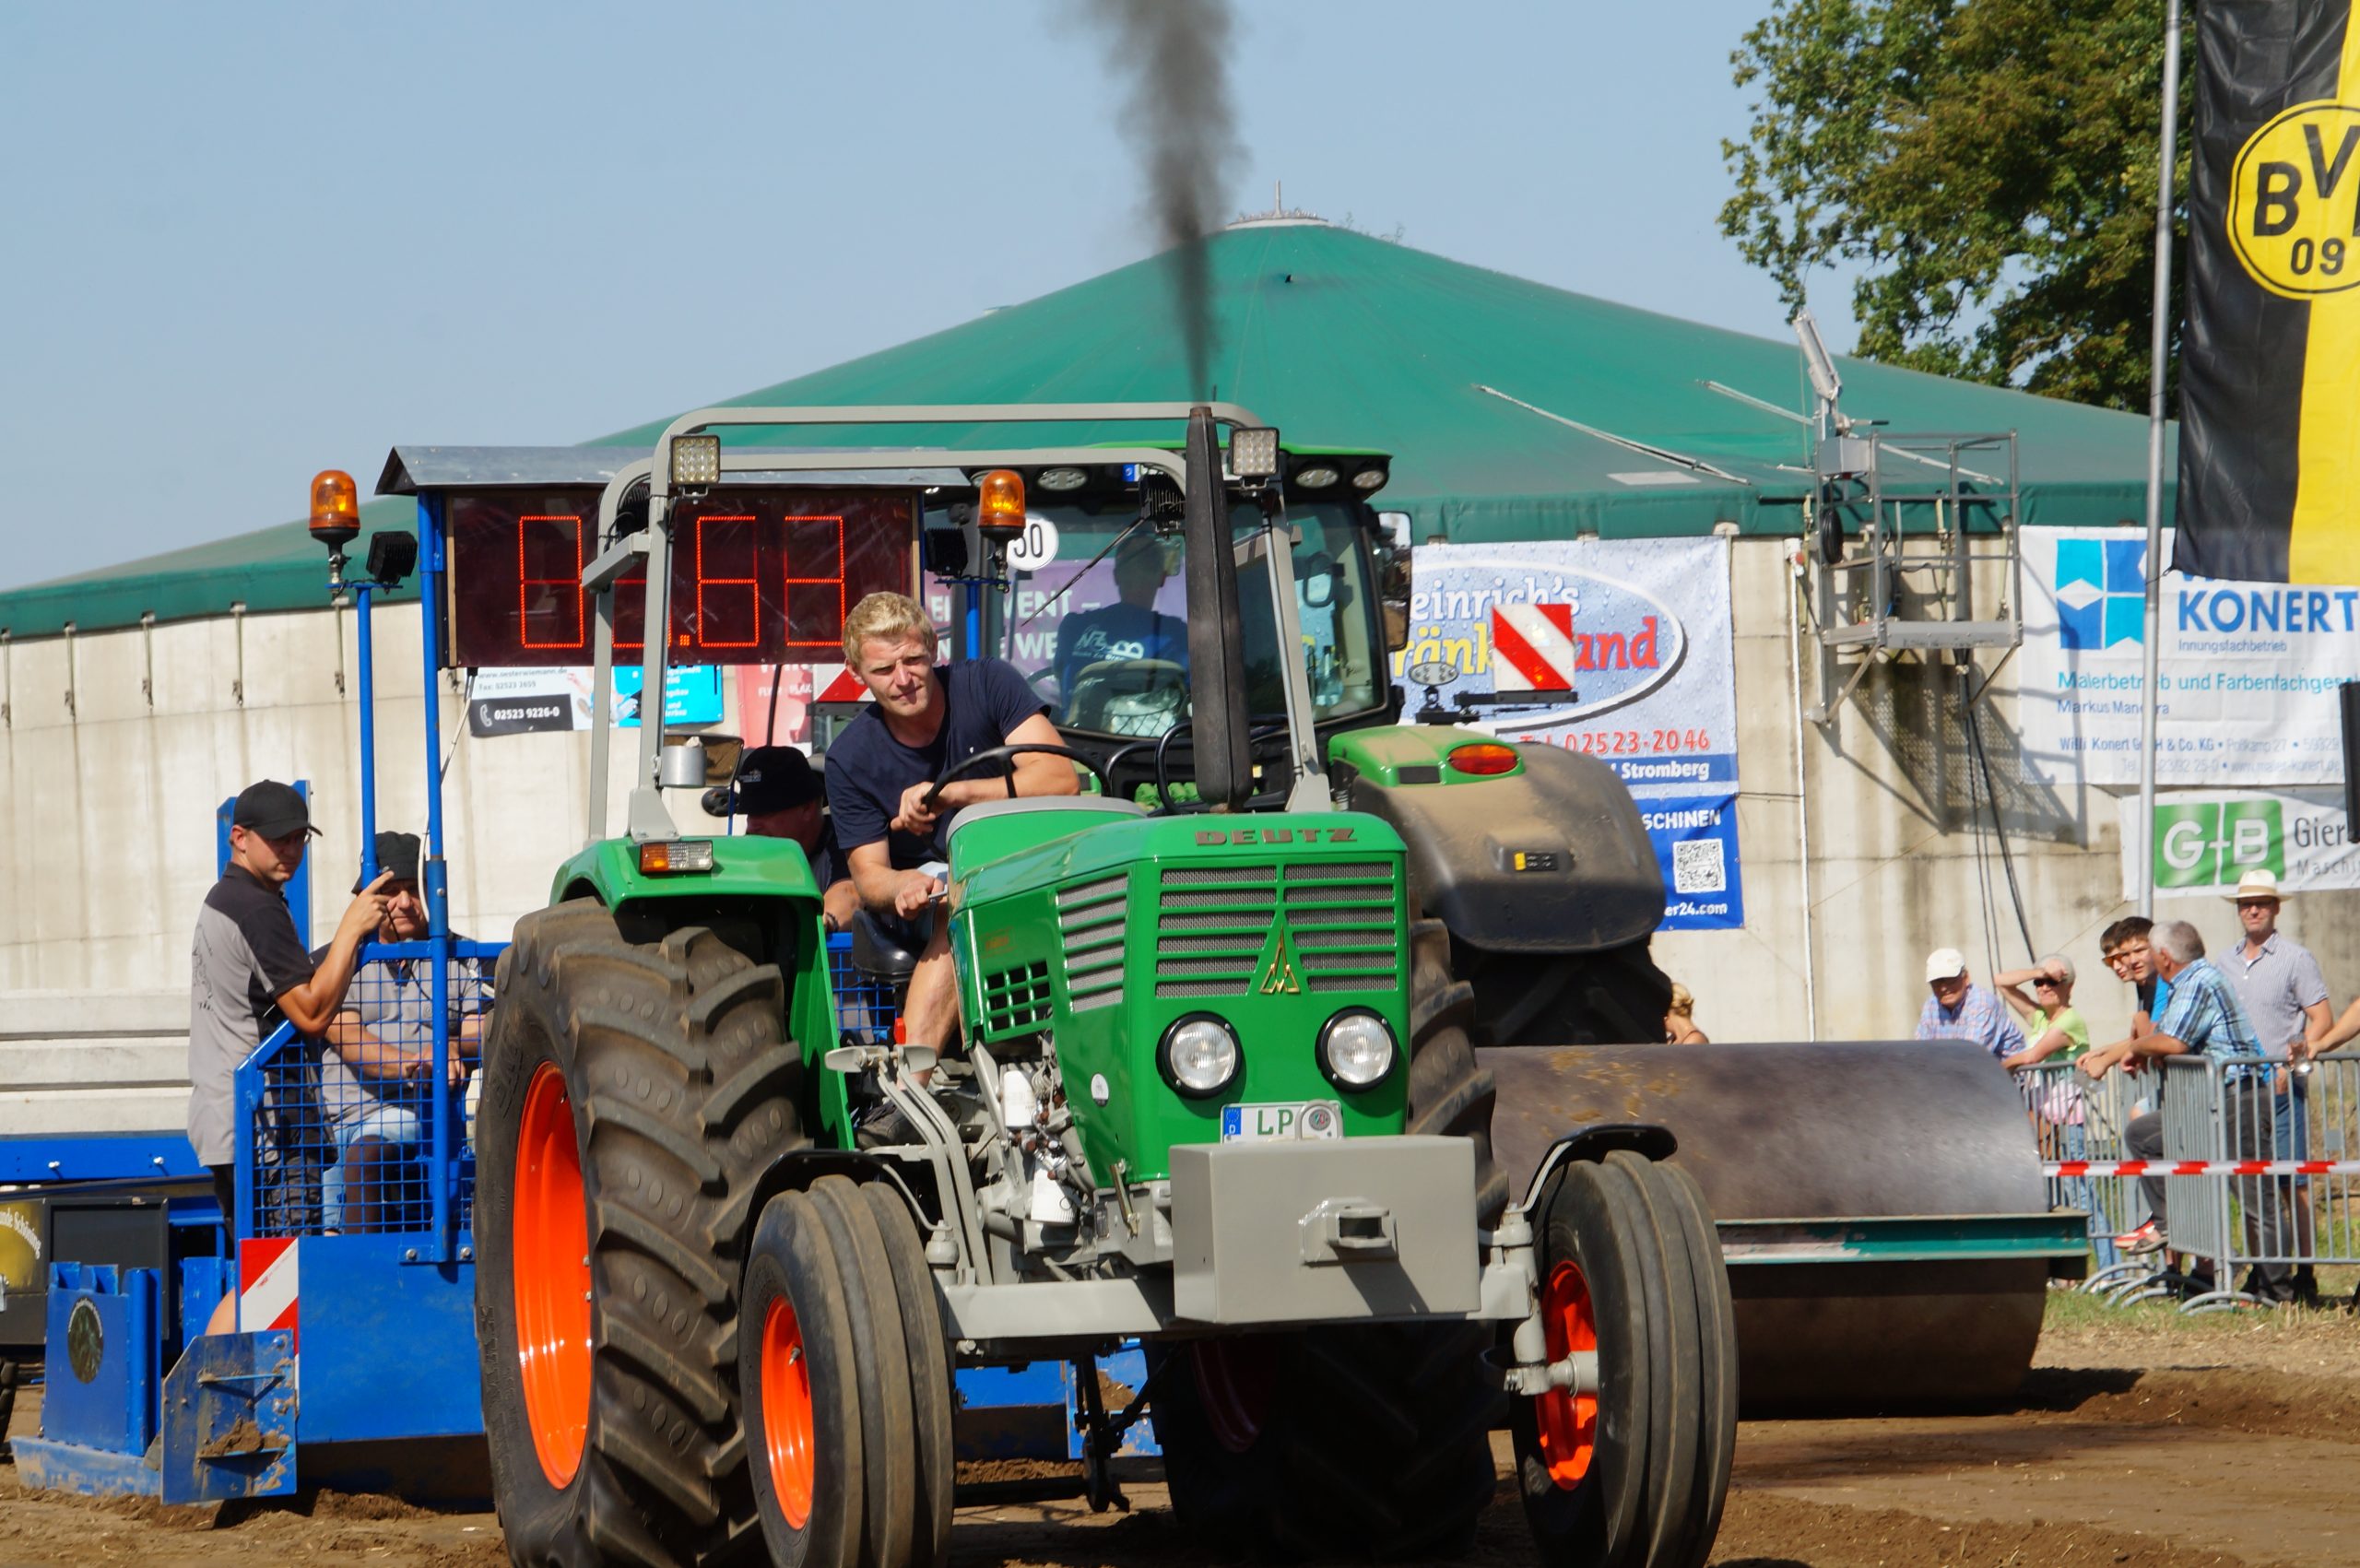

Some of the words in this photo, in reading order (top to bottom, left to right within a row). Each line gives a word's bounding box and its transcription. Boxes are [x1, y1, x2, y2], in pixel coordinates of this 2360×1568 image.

[2253, 124, 2360, 237] BV
[2291, 238, 2345, 276] 09
[1410, 576, 1581, 621] einrich's
[2178, 589, 2359, 632] KONERT
[2178, 639, 2287, 654] Innungsfachbetrieb
[2177, 673, 2211, 690] und
[493, 709, 525, 721] 02523
[525, 705, 560, 718] 9226-0
[2058, 699, 2110, 713] Markus
[2092, 738, 2130, 751] Konert
[1621, 761, 1710, 781] Stromberg
[1642, 809, 1721, 831] SCHINEN
[1195, 827, 1358, 846] DEUTZ
[1663, 902, 1729, 916] er24.com
[1257, 1109, 1294, 1135] LP
